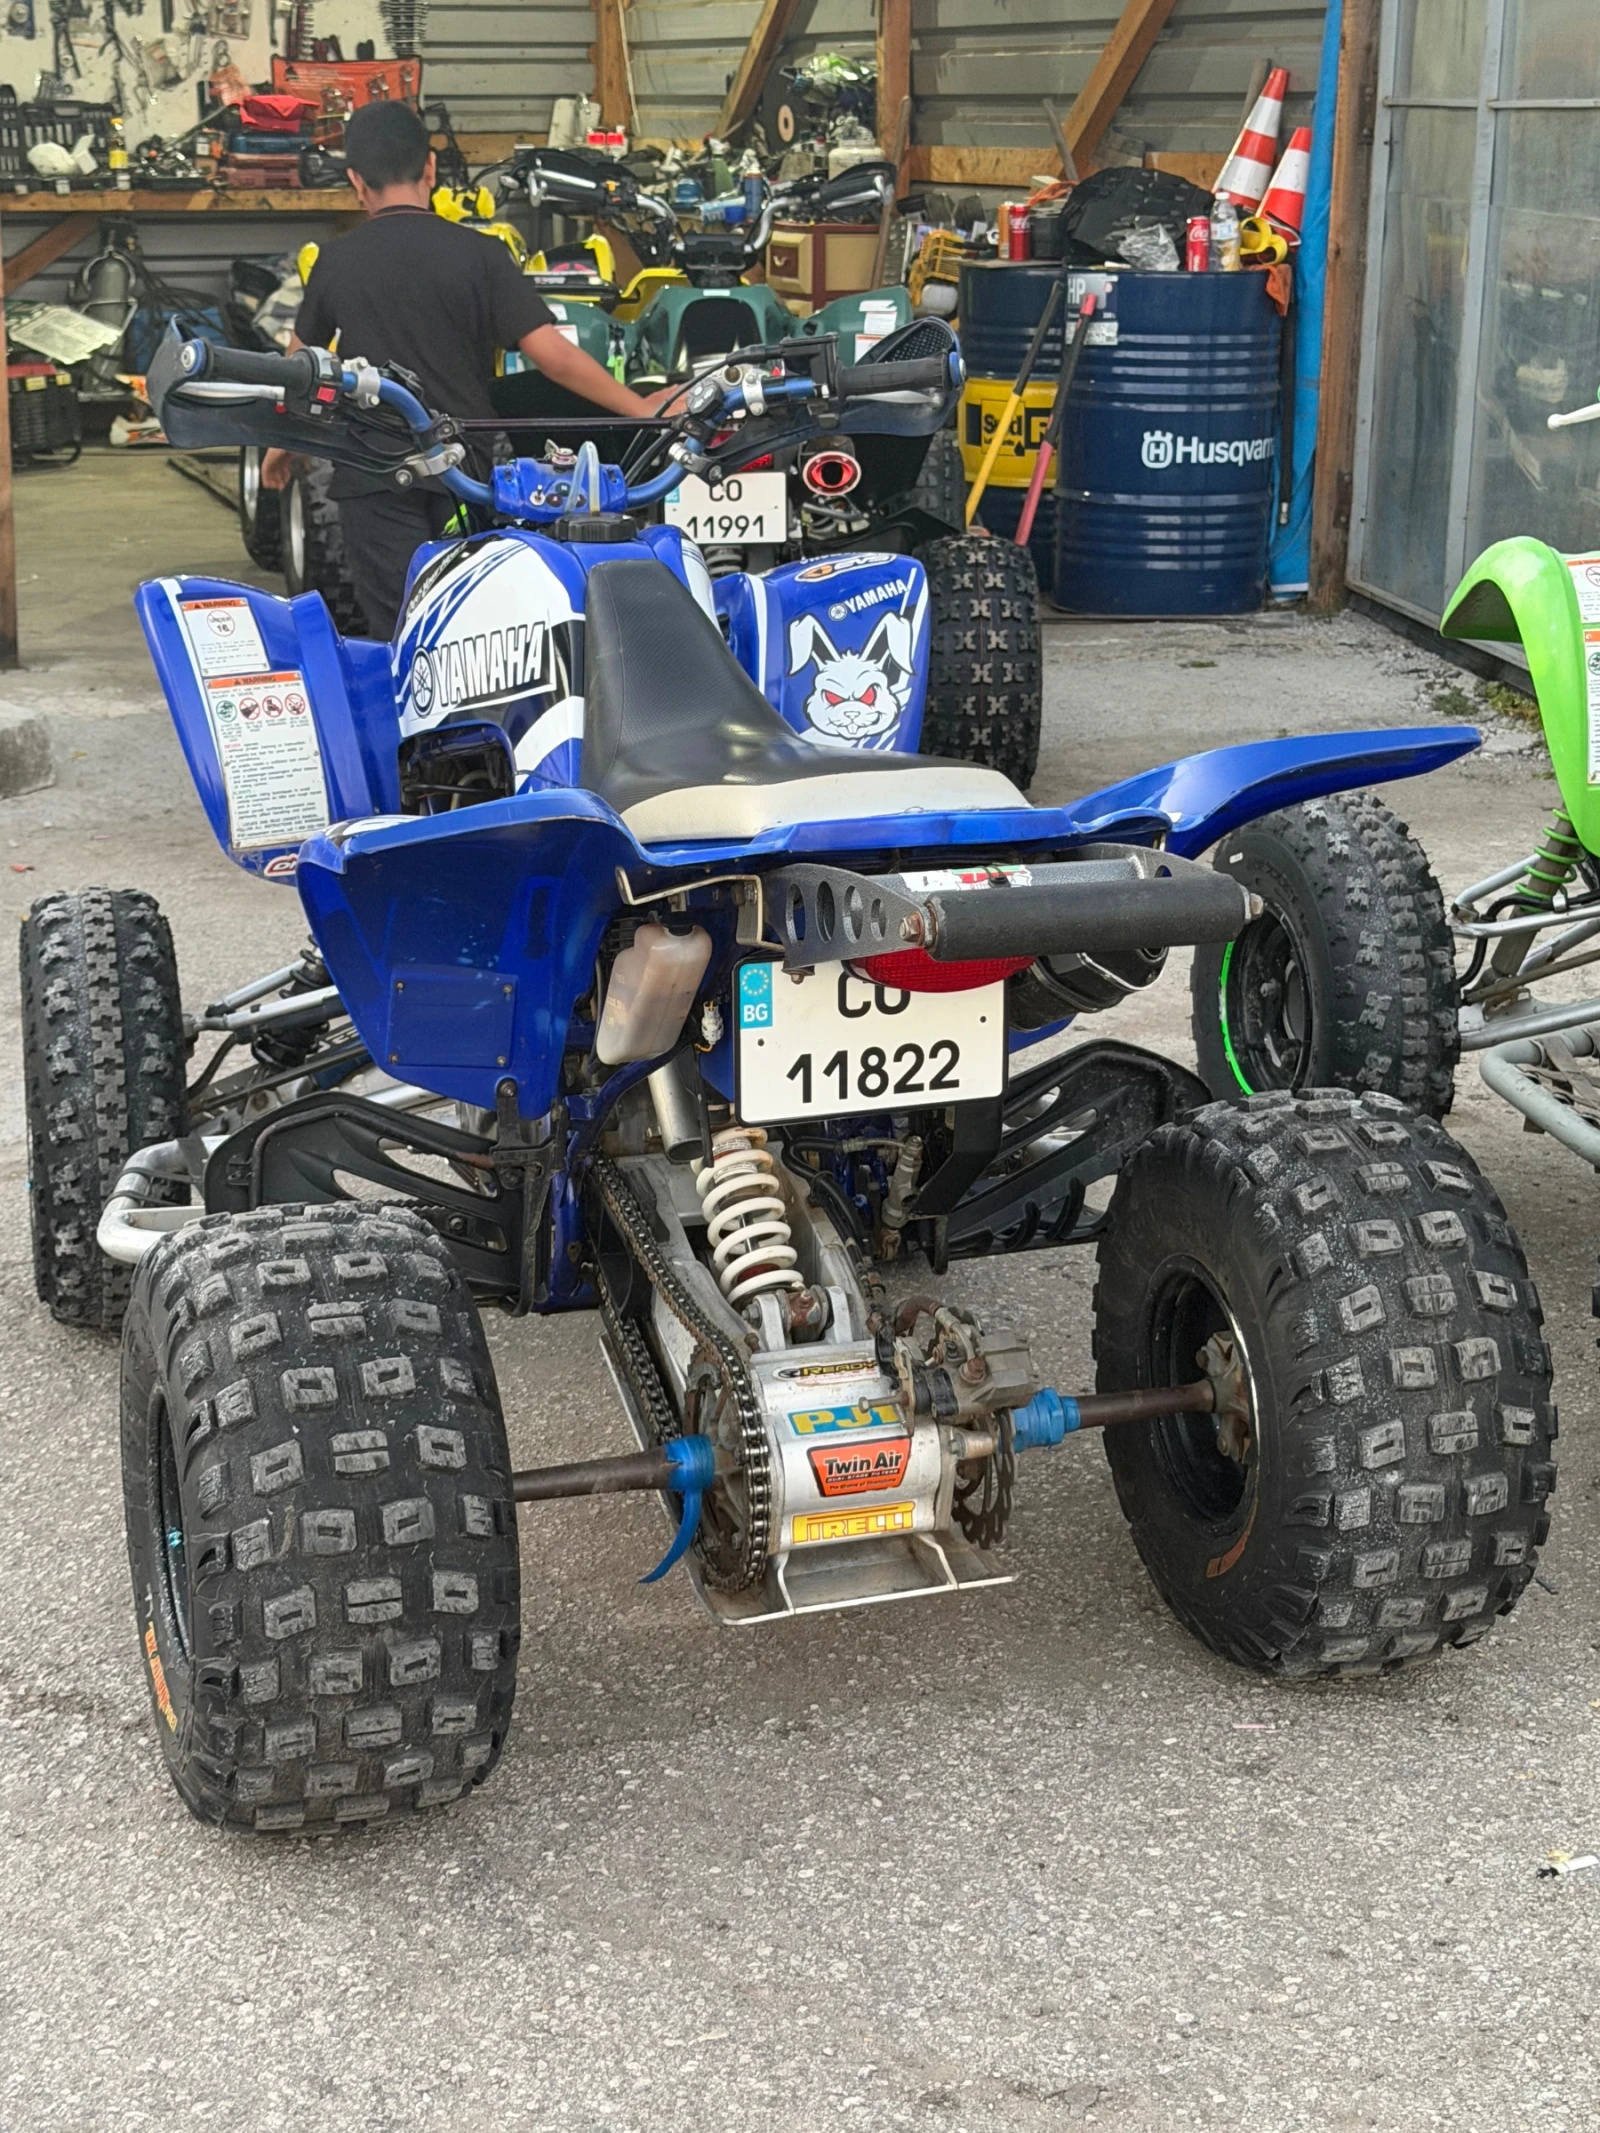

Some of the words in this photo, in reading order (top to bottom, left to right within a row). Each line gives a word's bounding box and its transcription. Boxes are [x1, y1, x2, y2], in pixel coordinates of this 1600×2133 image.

[984, 414, 1022, 436] Sd
[709, 480, 742, 502] CO
[686, 515, 764, 538] 11991
[844, 579, 909, 614] YAMAHA
[430, 621, 546, 707] YAMAHA
[743, 1003, 768, 1022] BG
[786, 1039, 960, 1103] 11822
[792, 1404, 900, 1434] PJ1
[825, 1456, 871, 1475] Twin
[873, 1451, 902, 1470] Air
[793, 1501, 916, 1544] PIRELLI
